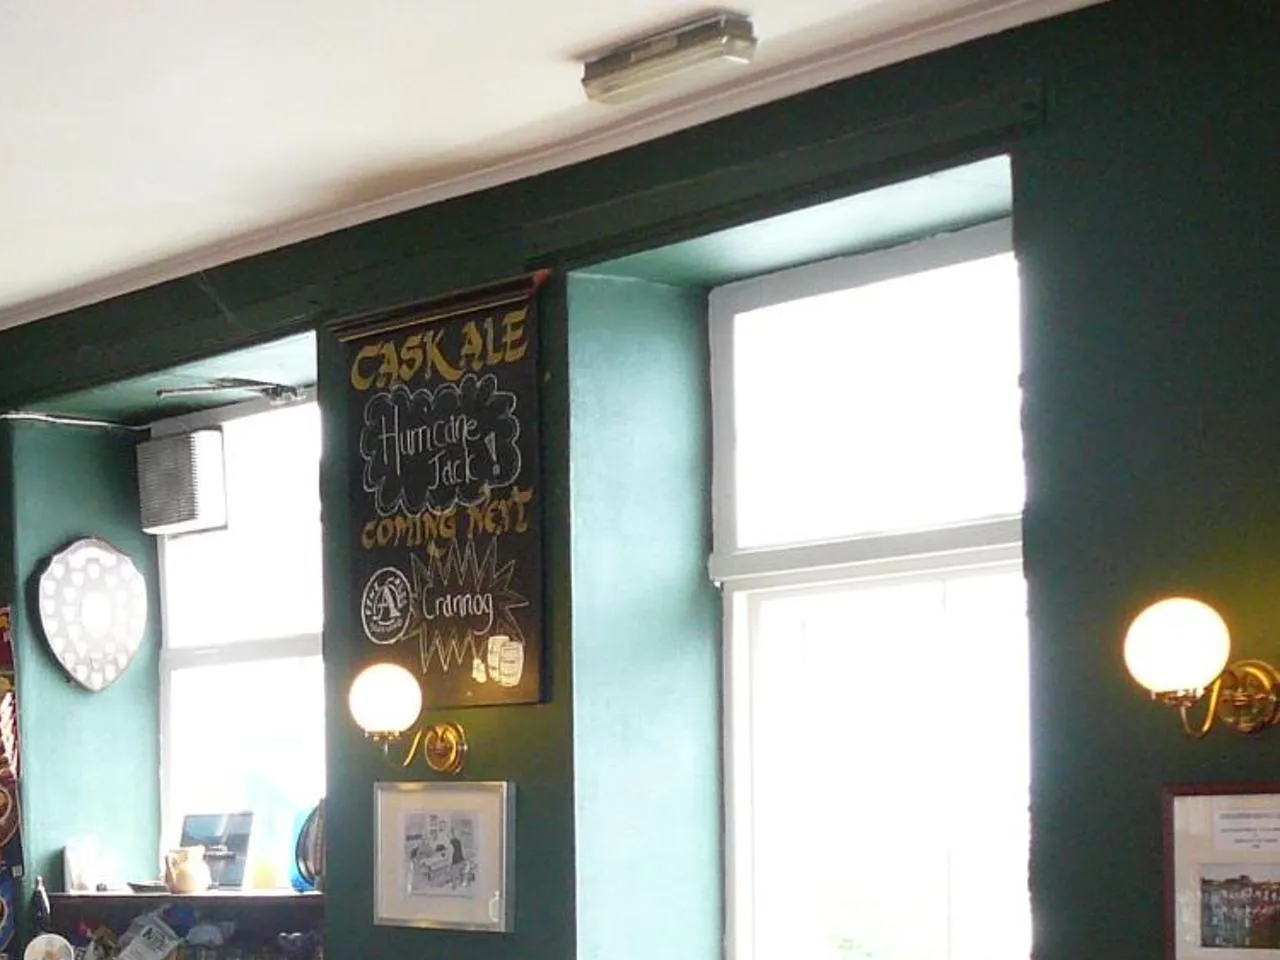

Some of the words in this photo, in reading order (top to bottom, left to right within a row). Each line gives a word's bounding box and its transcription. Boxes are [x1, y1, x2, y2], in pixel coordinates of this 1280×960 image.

[351, 328, 464, 391] CASK
[459, 305, 529, 371] ALE
[379, 405, 481, 477] Hurricane
[428, 449, 479, 490] Jack
[361, 506, 456, 549] COMING
[467, 487, 534, 540] NEXT
[422, 583, 494, 636] Crannog
